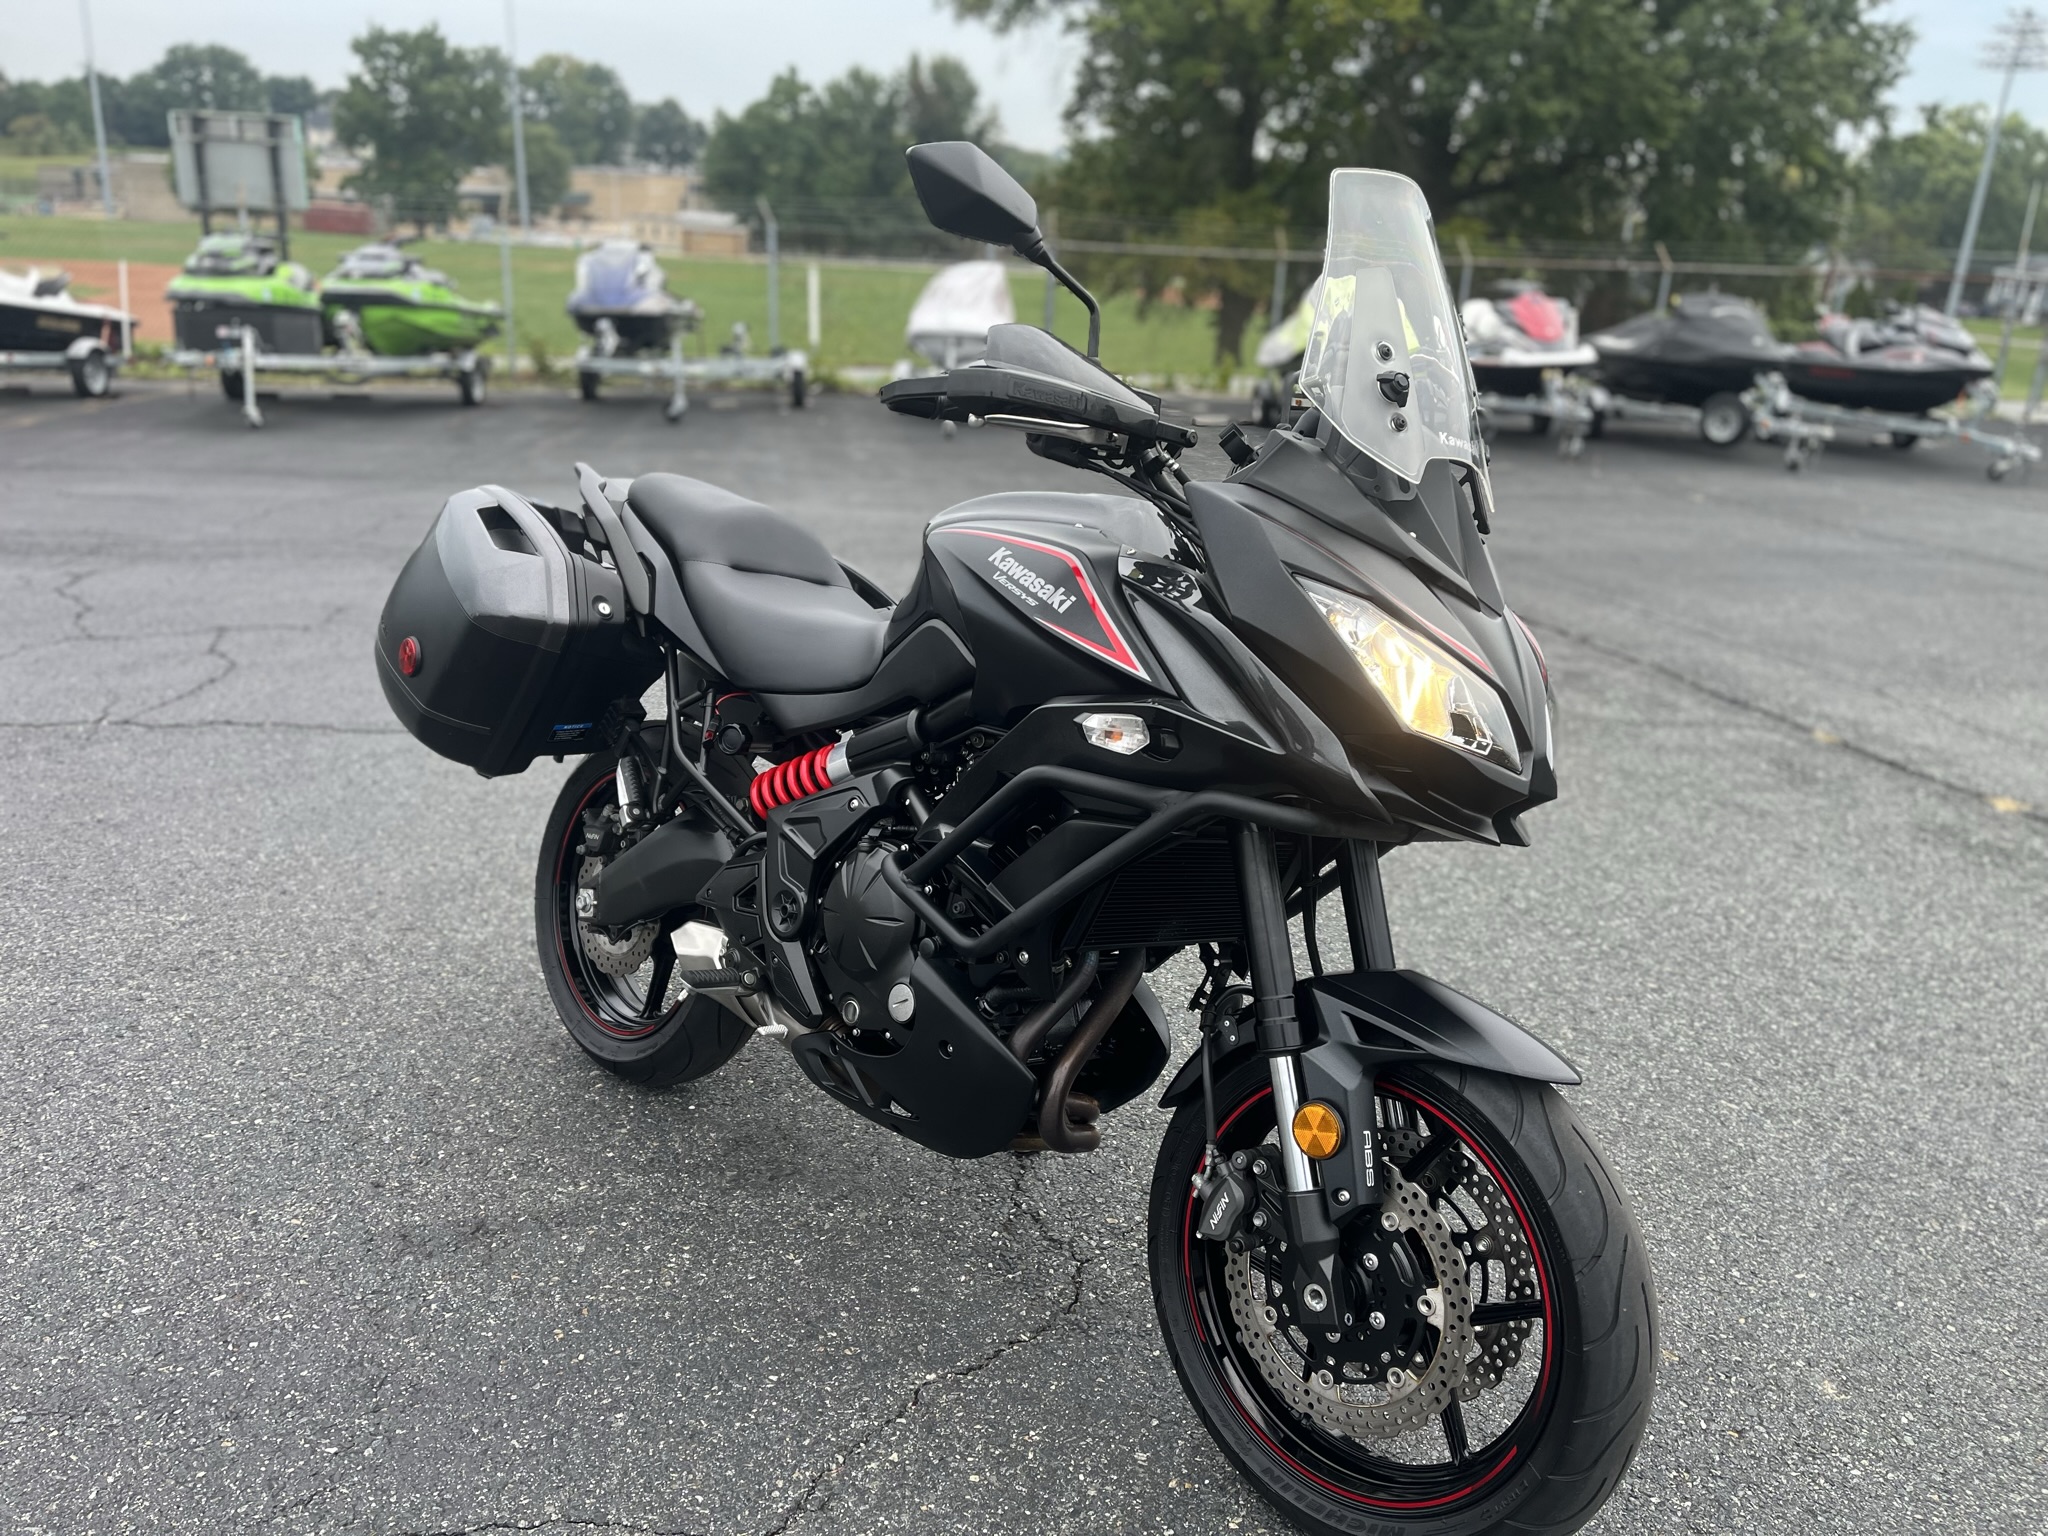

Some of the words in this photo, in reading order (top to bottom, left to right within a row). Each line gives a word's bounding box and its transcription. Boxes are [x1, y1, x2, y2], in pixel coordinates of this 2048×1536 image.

[987, 546, 1077, 614] Kawasaki
[1362, 1130, 1375, 1187] ABS
[1259, 1464, 1406, 1536] MICHELIN
